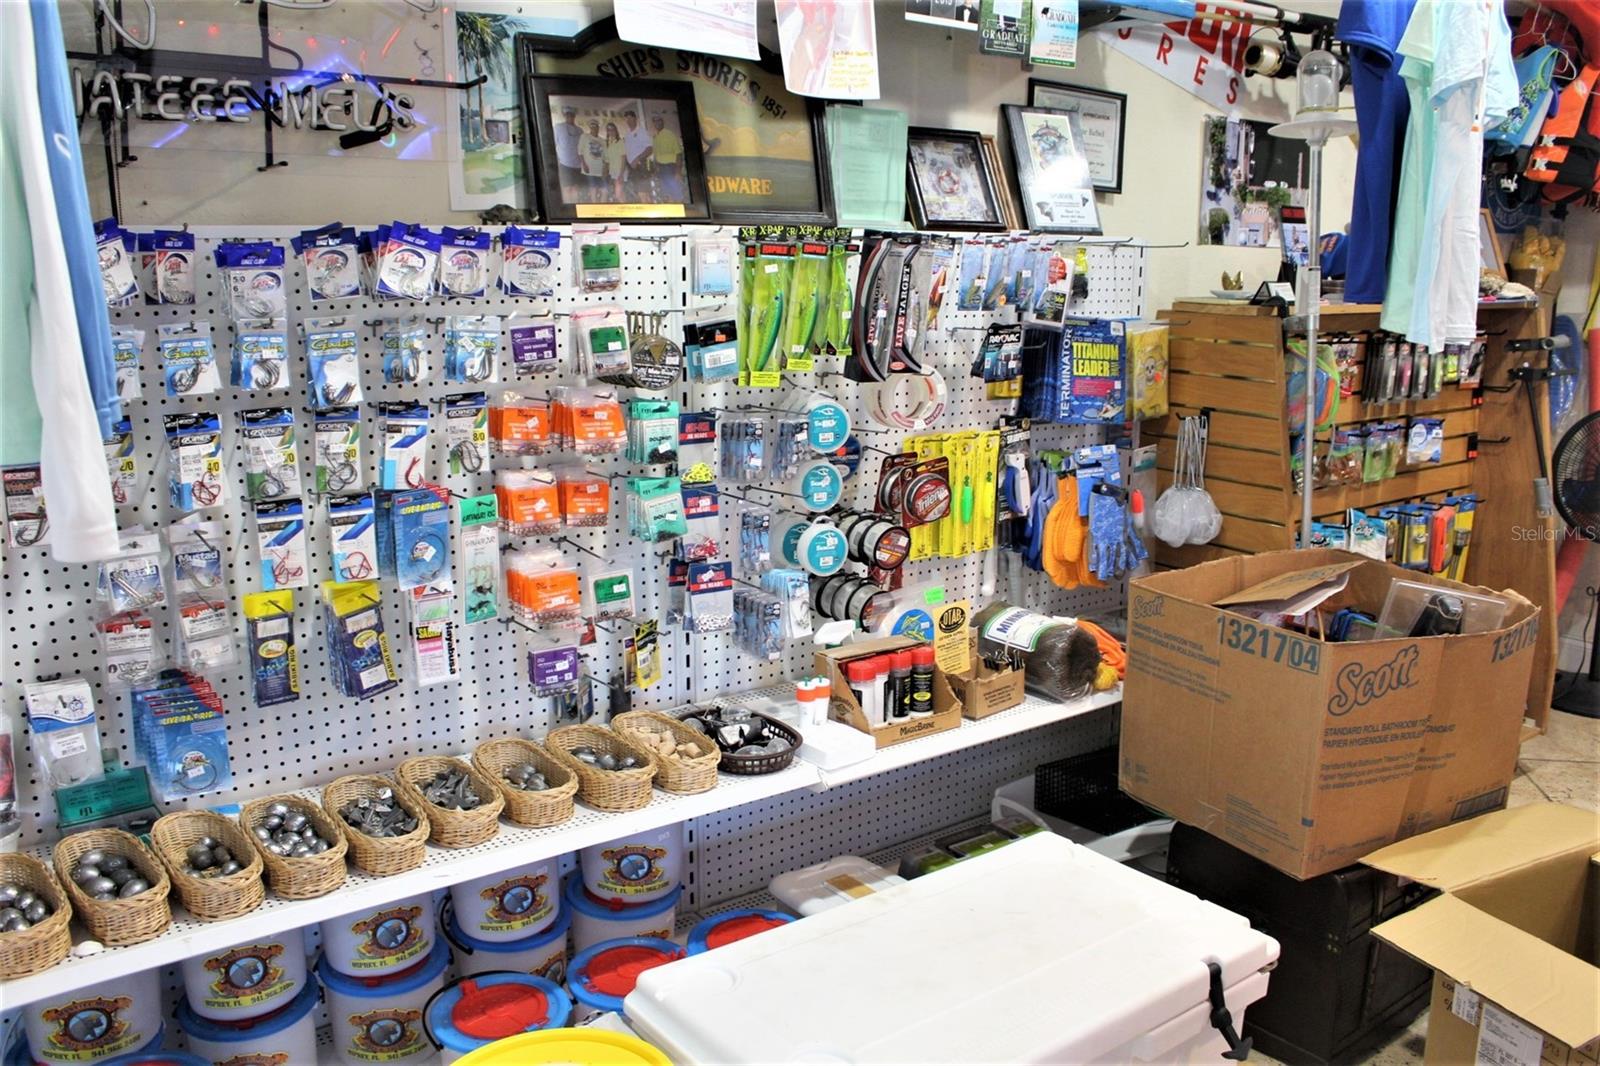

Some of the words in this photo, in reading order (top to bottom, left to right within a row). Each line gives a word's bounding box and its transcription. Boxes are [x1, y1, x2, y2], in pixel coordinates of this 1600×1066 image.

[983, 29, 1027, 44] GRADUATE
[898, 266, 911, 317] TARGET
[895, 316, 906, 349] LIVE
[1072, 343, 1119, 361] TITANIUM
[1059, 328, 1074, 420] TERMINATOR
[1073, 359, 1111, 378] LEADER
[1133, 596, 1165, 619] Scott
[445, 621, 457, 675] Hayabusa
[1328, 649, 1419, 717] Scott
[1324, 727, 1362, 737] STANDARD
[1362, 724, 1381, 734] ROLL
